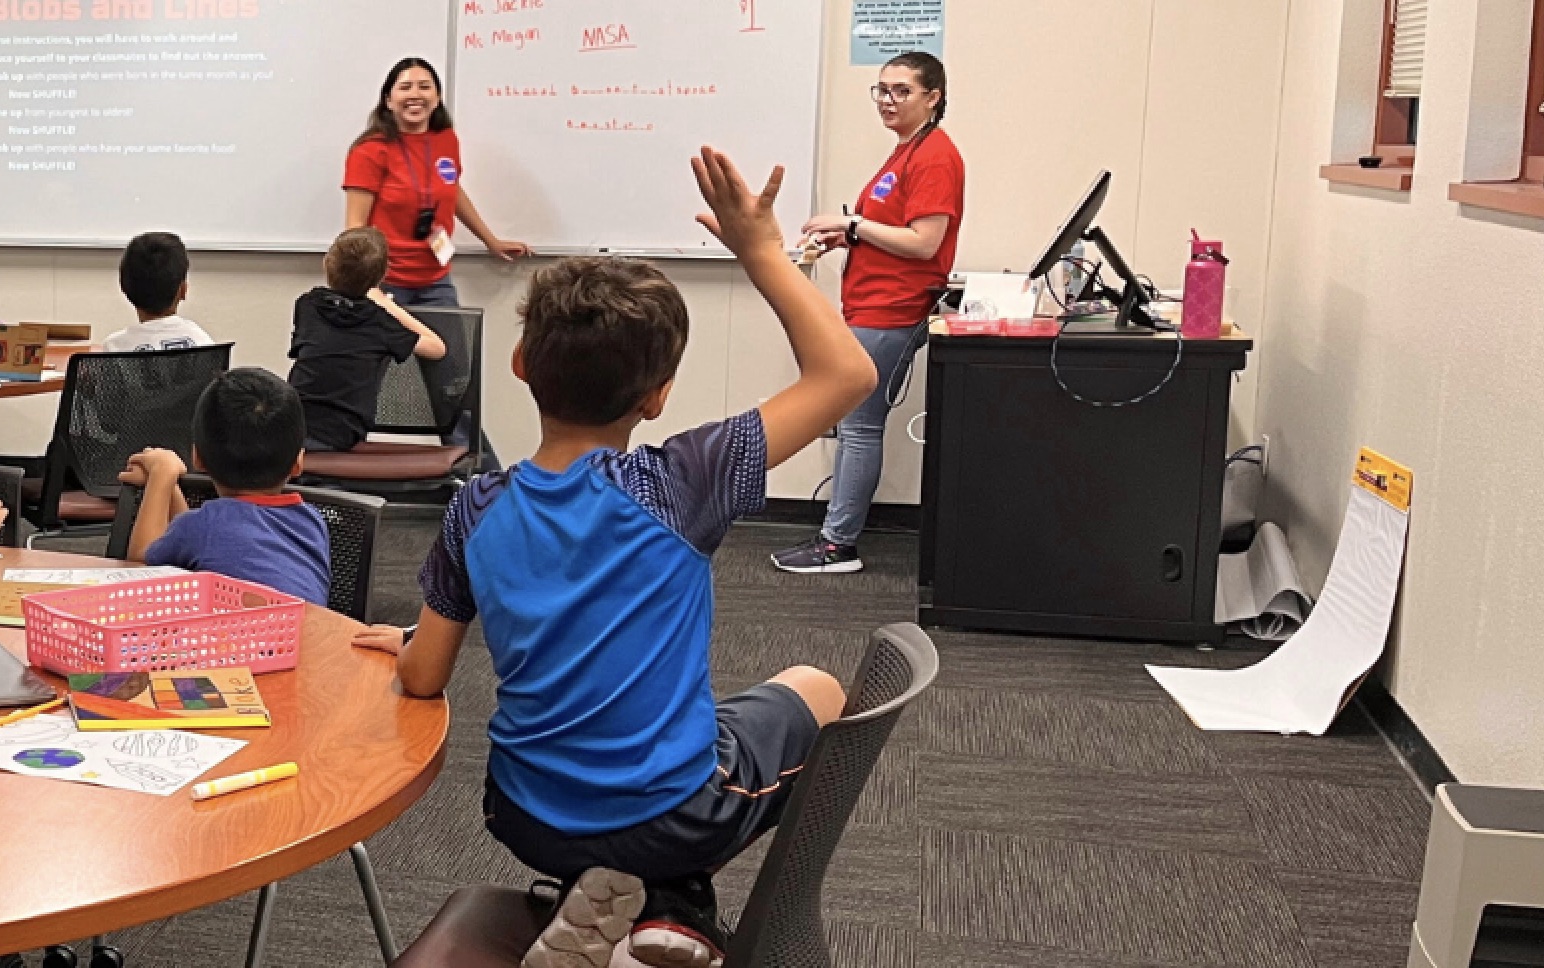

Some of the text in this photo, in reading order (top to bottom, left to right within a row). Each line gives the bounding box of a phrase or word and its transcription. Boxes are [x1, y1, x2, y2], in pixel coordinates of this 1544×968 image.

[92, 0, 153, 20] and
[165, 0, 259, 19] Lines
[582, 24, 630, 47] NASA
